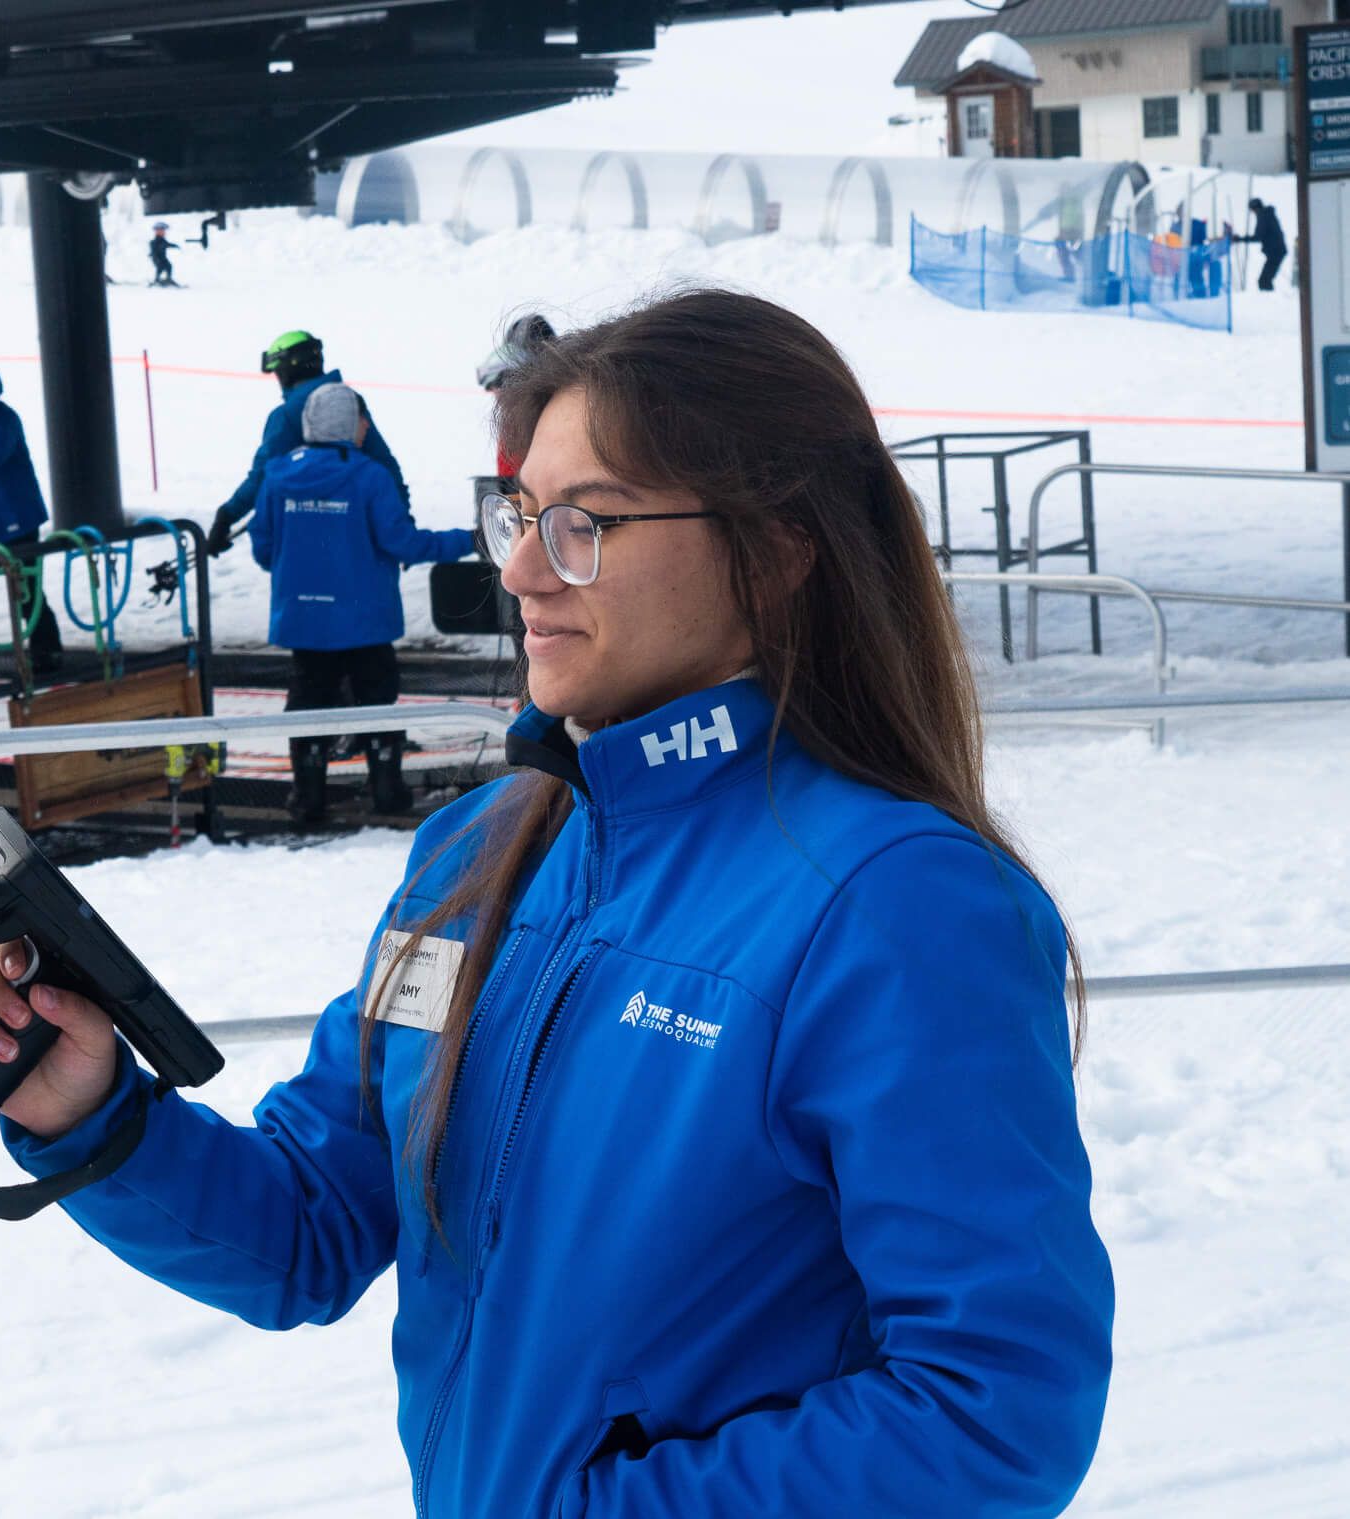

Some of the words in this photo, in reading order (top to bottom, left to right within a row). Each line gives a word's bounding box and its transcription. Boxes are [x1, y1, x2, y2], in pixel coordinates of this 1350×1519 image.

[640, 705, 738, 767] HH
[400, 983, 421, 999] AMY
[646, 1003, 673, 1022] THE
[674, 1013, 723, 1039] SUMMIT
[648, 1019, 717, 1049] SNOQUALMIE
